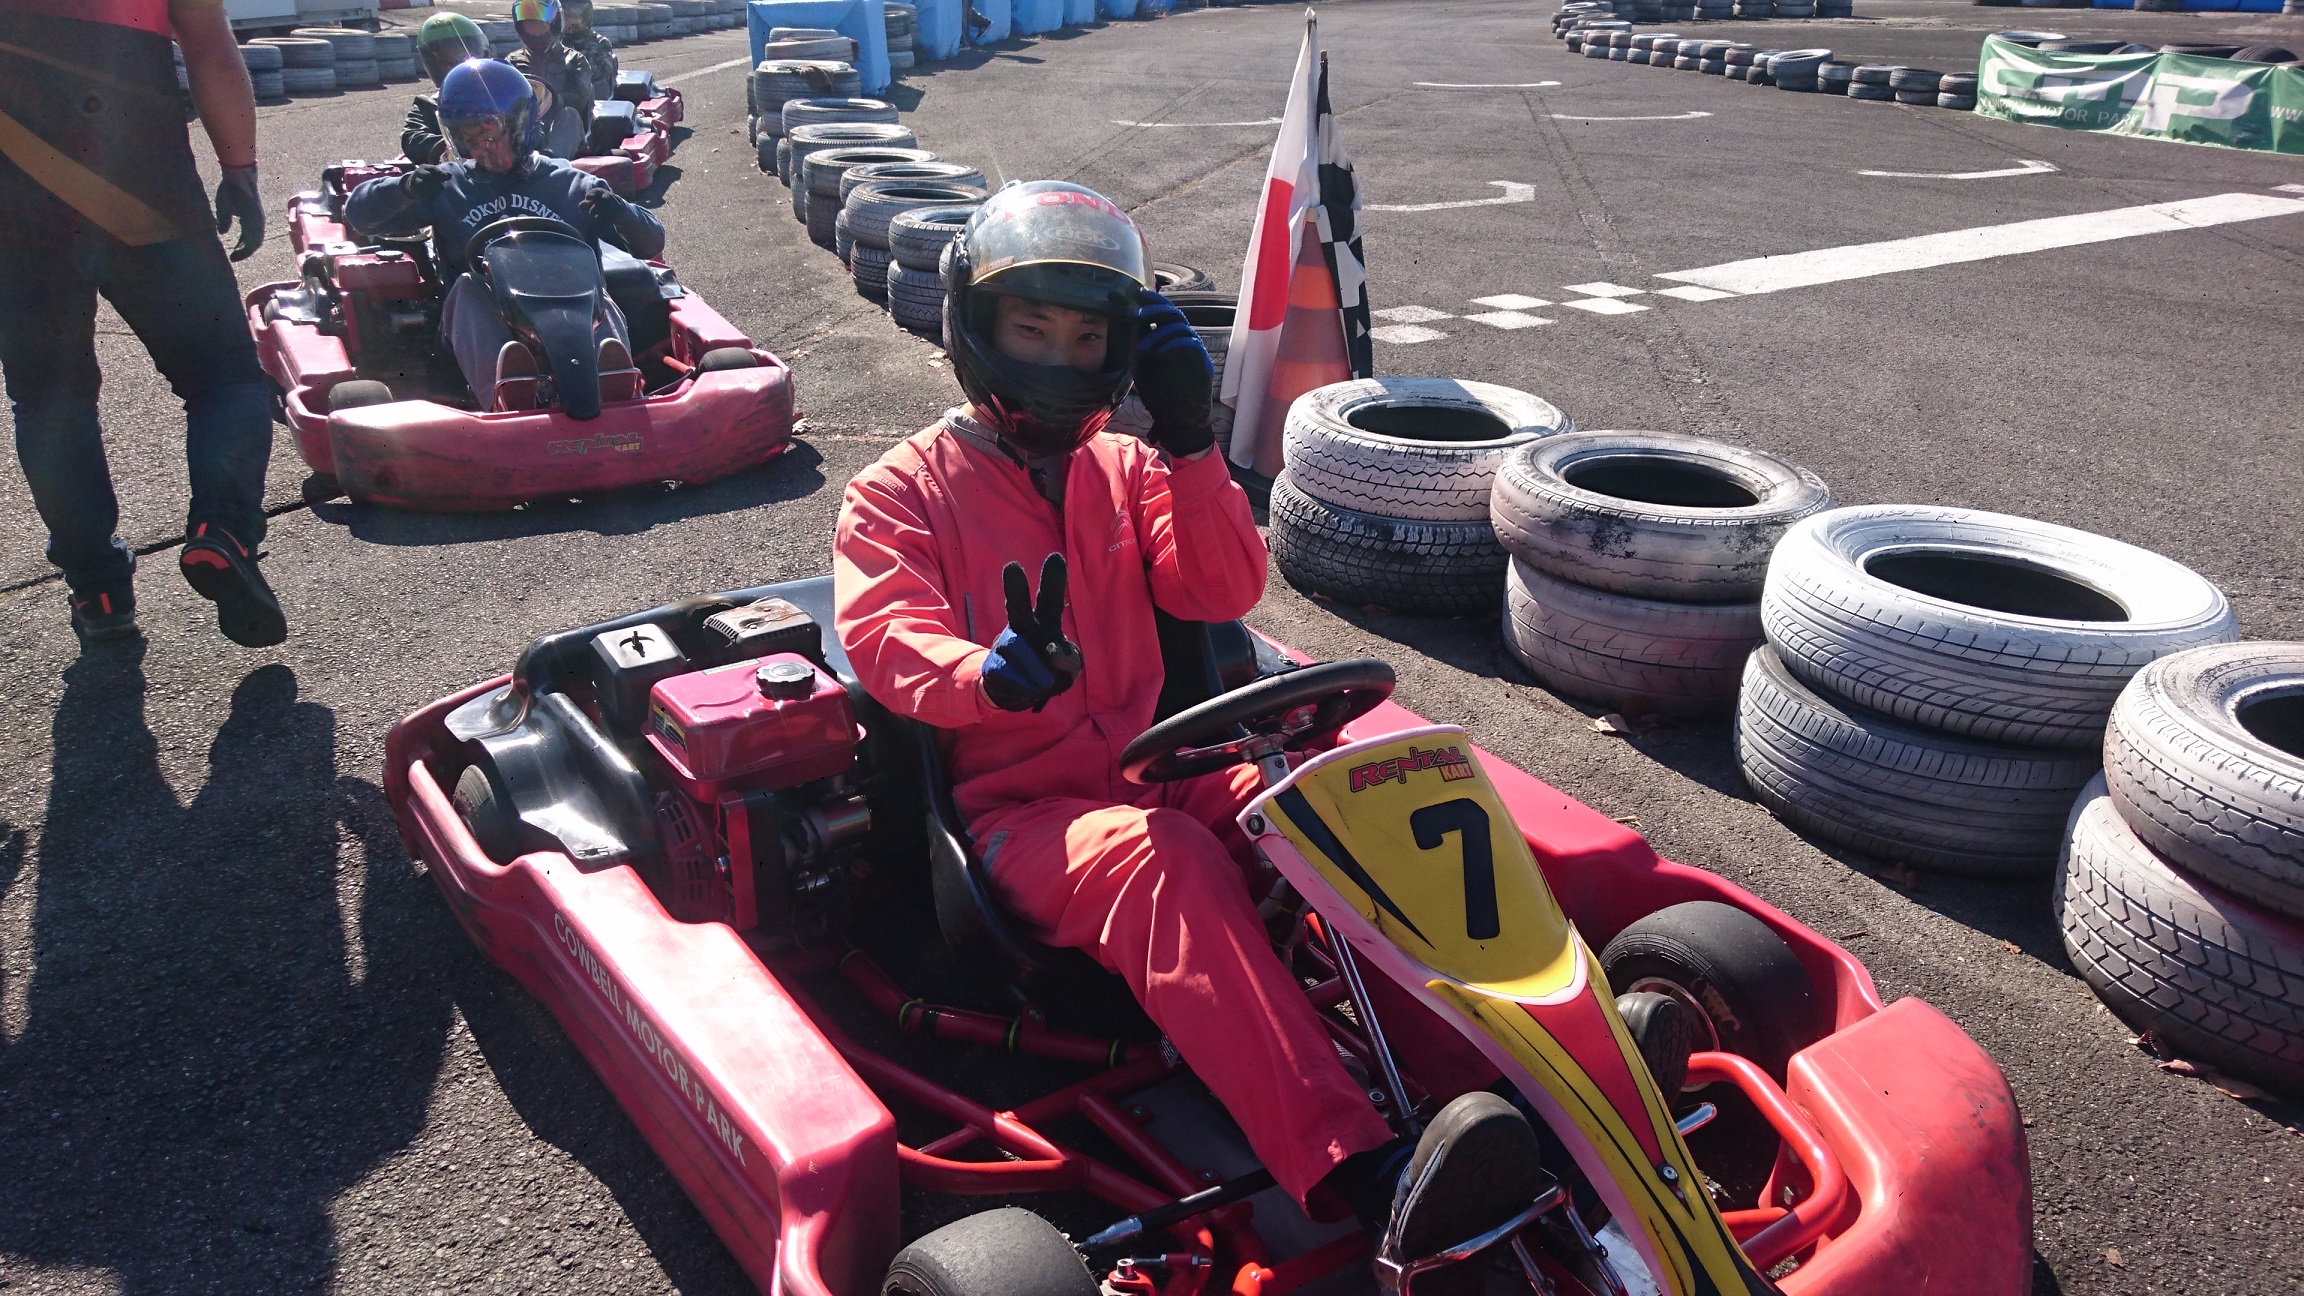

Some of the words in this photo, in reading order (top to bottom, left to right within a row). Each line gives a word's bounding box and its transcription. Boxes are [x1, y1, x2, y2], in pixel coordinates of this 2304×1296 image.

[2097, 111, 2140, 126] PARK
[462, 195, 507, 228] TOKYO
[1349, 747, 1468, 793] RENTAL
[1439, 762, 1475, 782] KART
[1410, 797, 1500, 940] 7
[554, 912, 624, 1016] COWBELL
[626, 1000, 691, 1099] MOTOR
[694, 1081, 747, 1168] PARK
